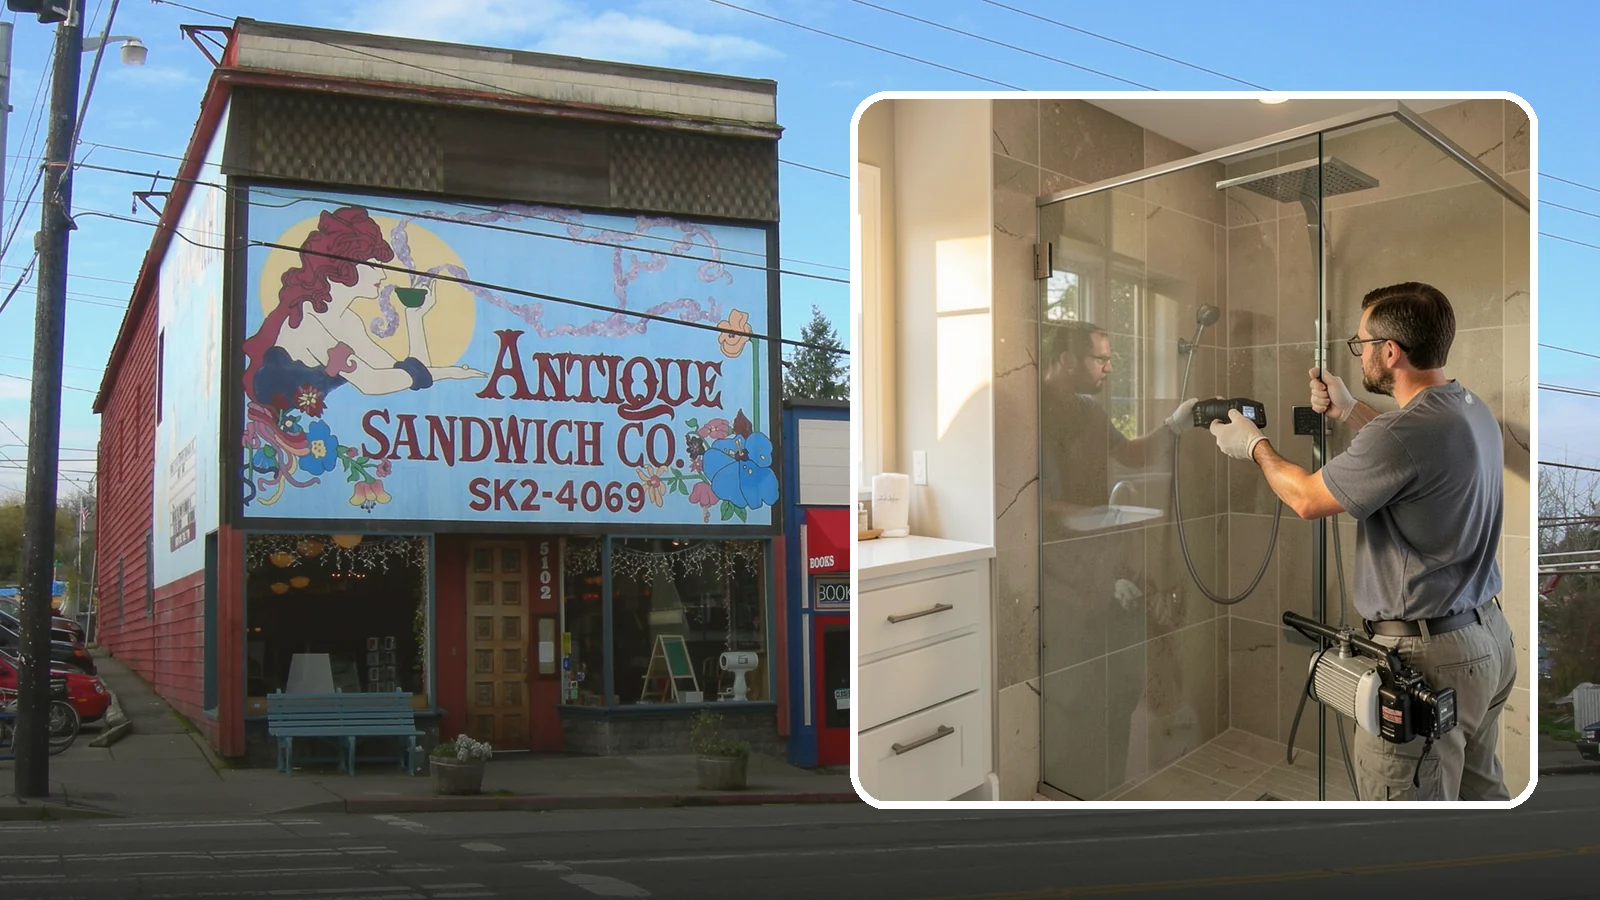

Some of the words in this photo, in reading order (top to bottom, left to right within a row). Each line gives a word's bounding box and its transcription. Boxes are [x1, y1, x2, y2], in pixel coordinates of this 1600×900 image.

[475, 328, 723, 420] ANTIQUE
[361, 408, 605, 467] SANDWICH
[616, 422, 685, 469] CO.
[468, 476, 646, 513] SK2-4069
[540, 541, 551, 599] 5102
[809, 555, 835, 569] BOOKS
